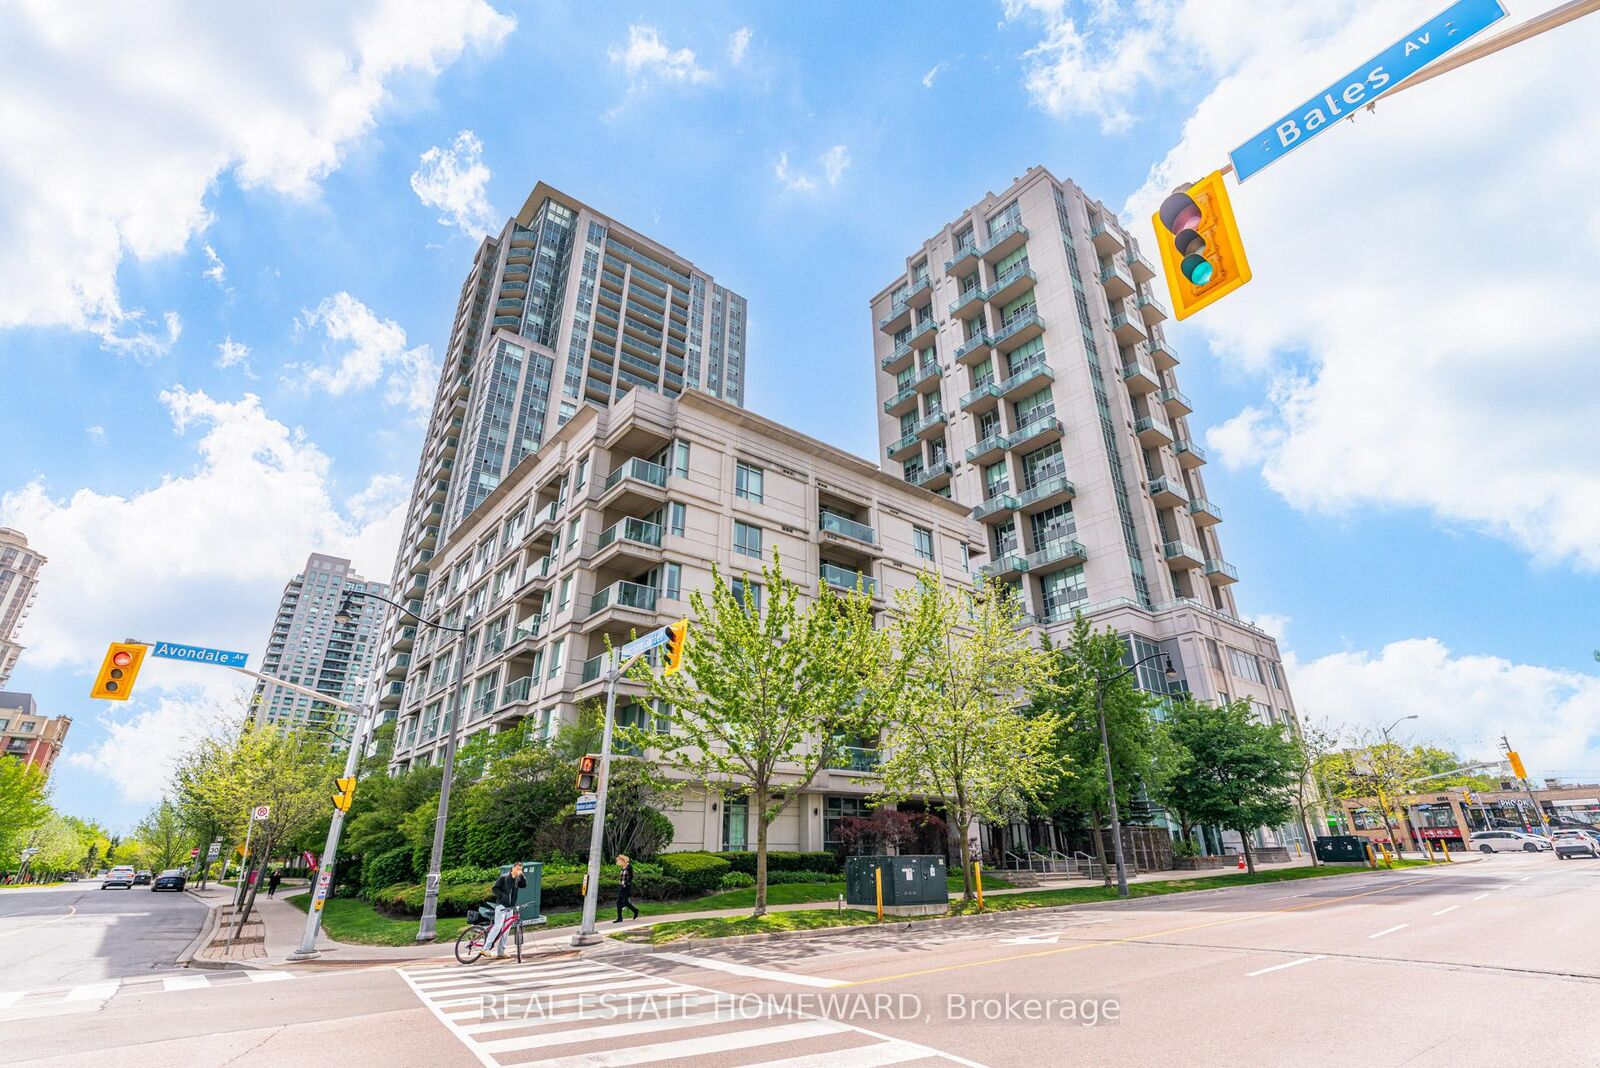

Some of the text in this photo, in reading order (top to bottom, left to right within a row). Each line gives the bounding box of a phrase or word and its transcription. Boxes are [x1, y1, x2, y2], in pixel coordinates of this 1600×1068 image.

[1275, 31, 1431, 148] Bales Av
[157, 643, 228, 662] Avondale
